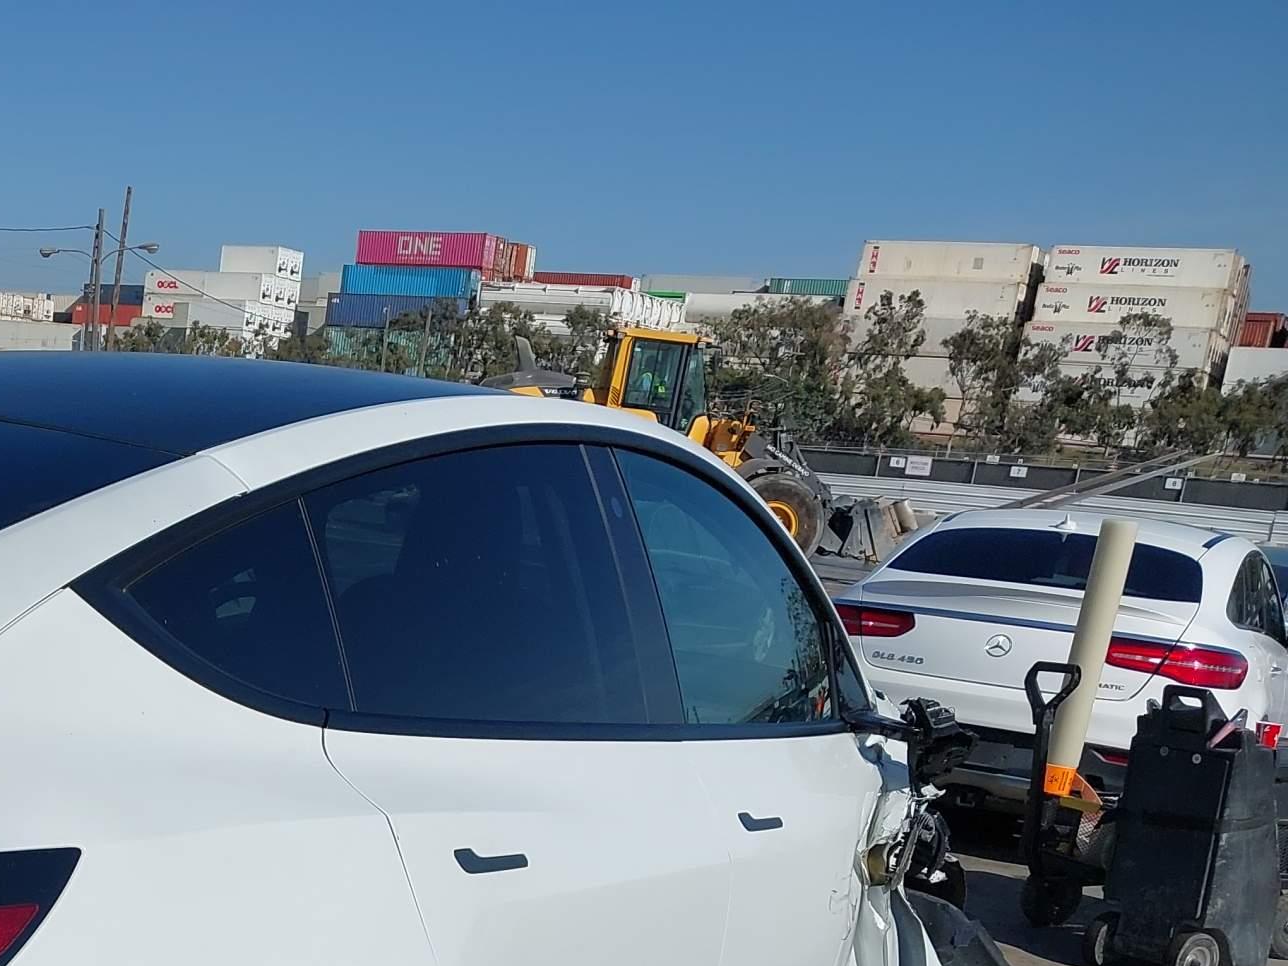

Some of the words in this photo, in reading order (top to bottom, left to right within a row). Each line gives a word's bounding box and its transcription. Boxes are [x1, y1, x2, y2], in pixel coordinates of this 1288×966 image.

[397, 236, 442, 255] ONE
[1122, 257, 1180, 268] HORIZON
[157, 280, 179, 289] OOCL
[1110, 296, 1167, 307] HORIZON
